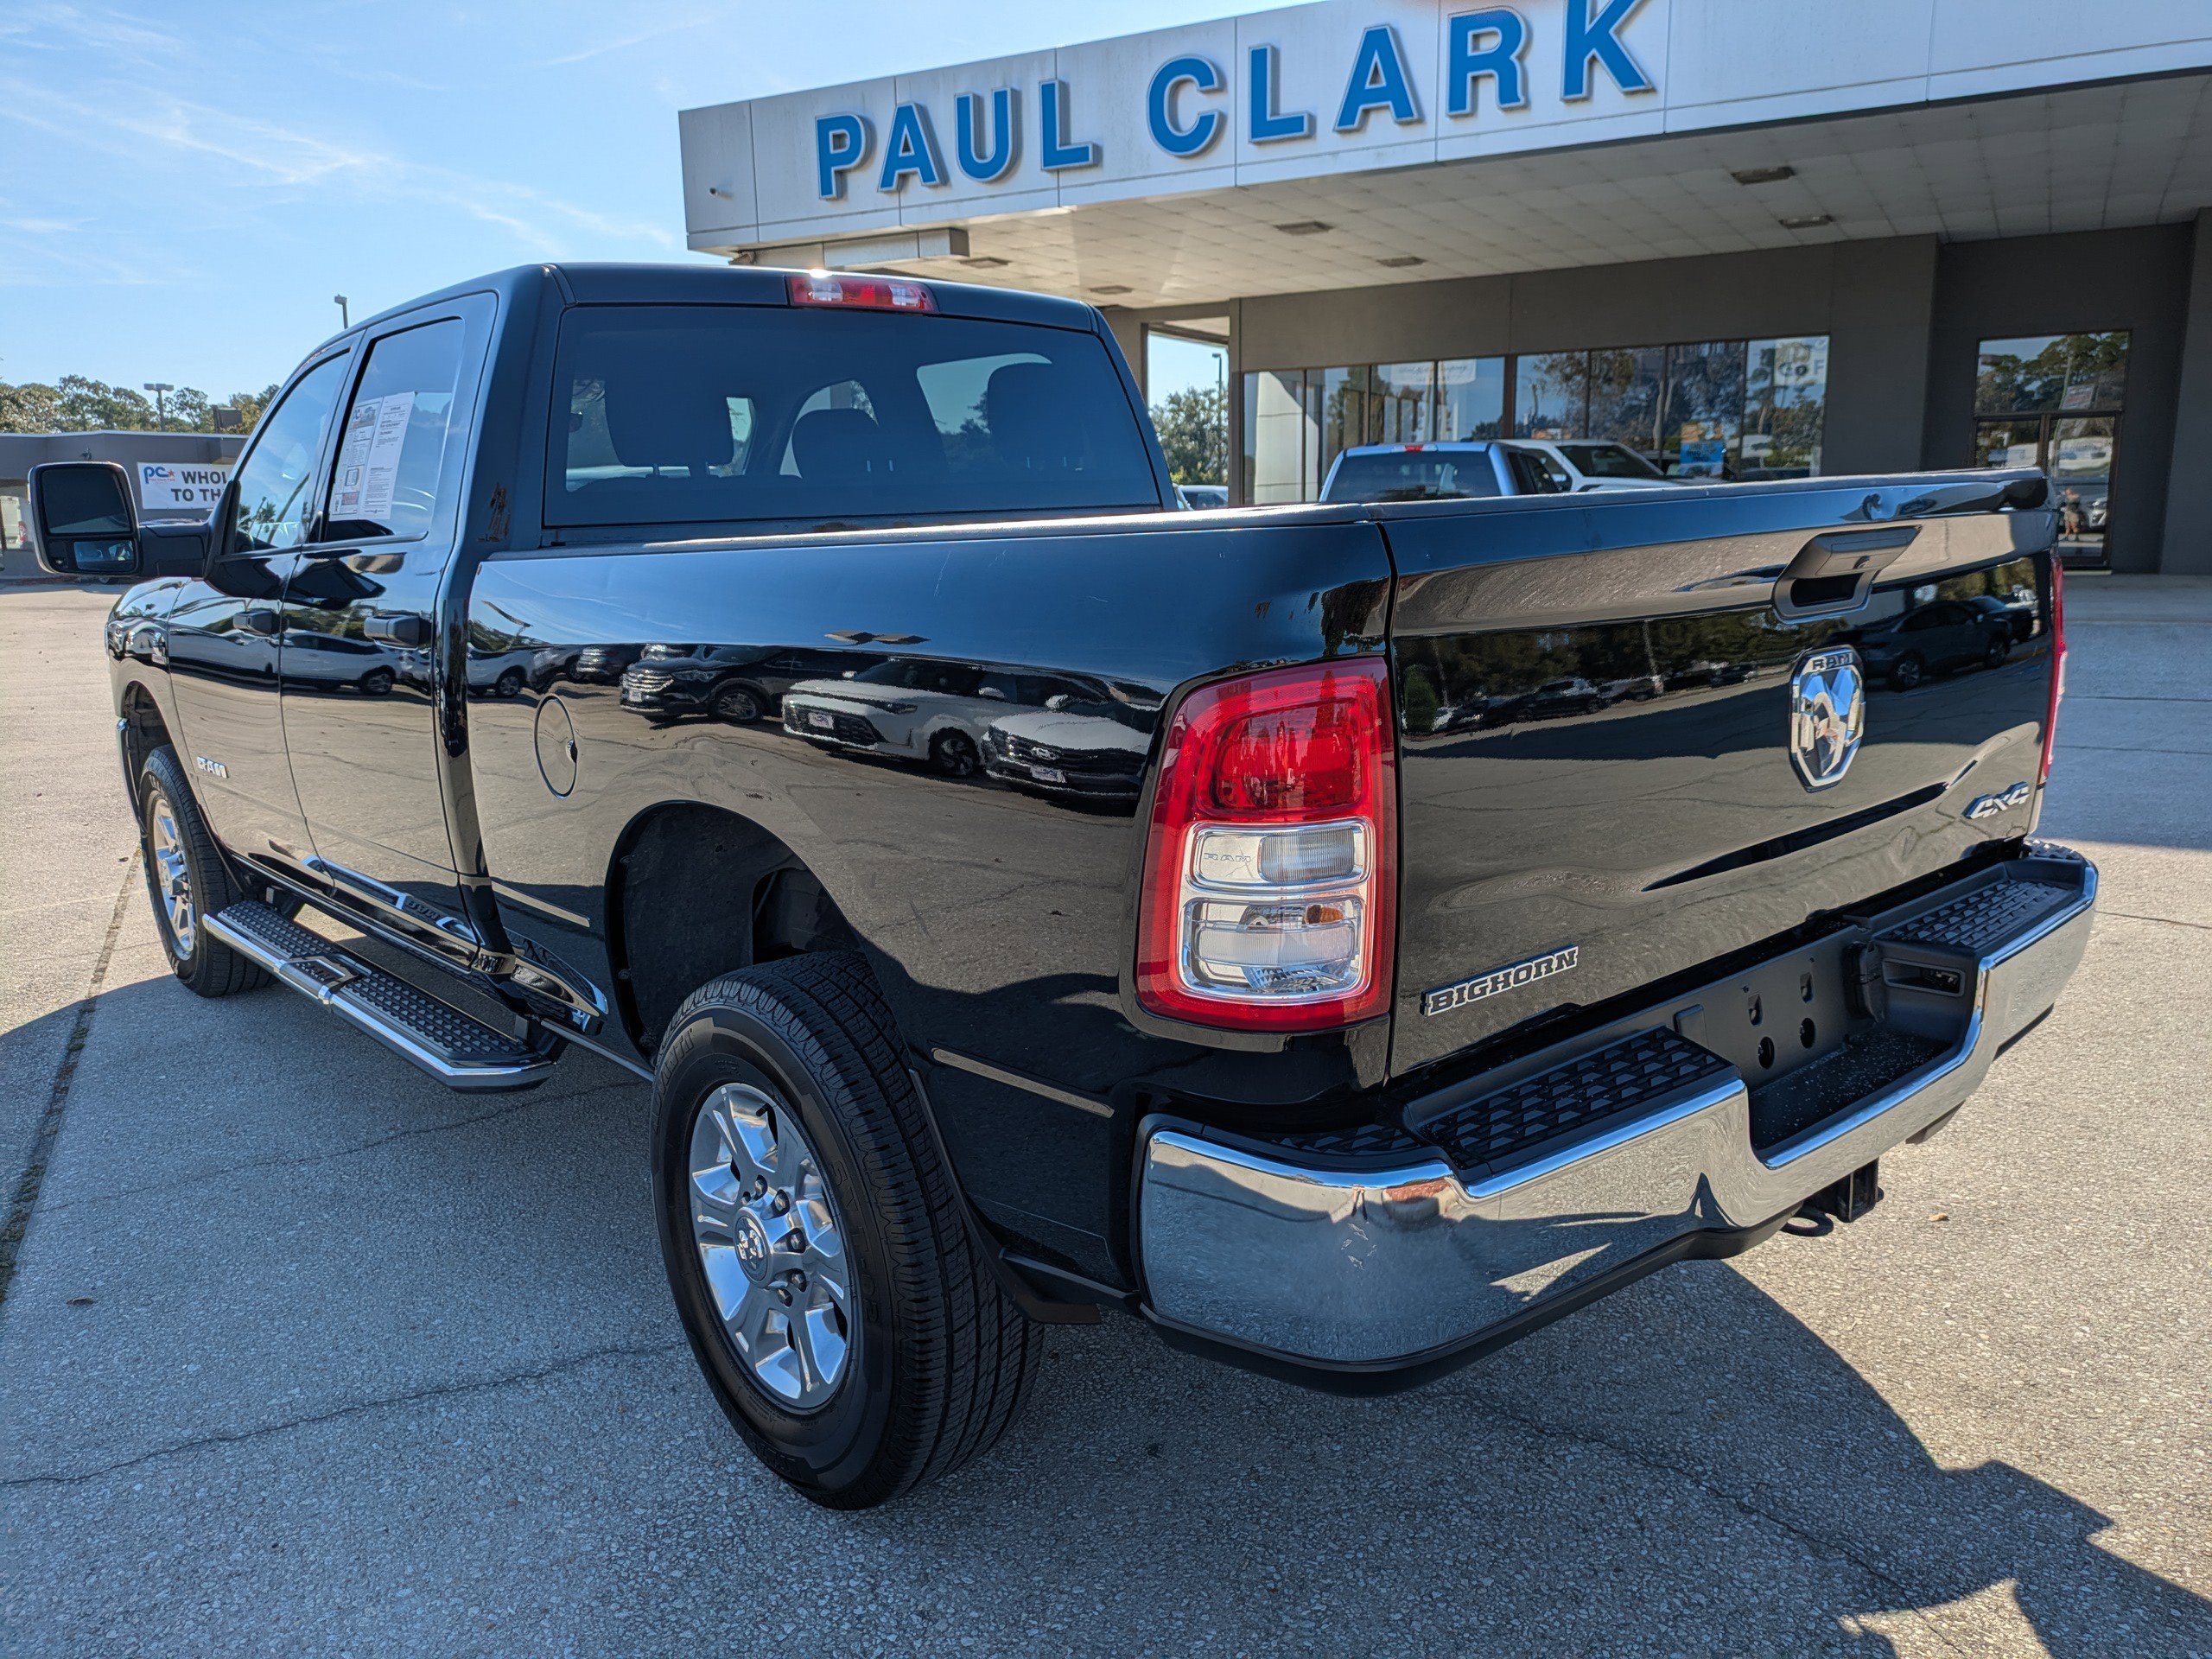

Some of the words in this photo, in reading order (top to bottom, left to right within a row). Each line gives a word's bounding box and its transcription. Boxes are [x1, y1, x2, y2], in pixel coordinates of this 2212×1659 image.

[815, 78, 1100, 200] PAUL
[1147, 0, 1652, 157] CLARK
[171, 488, 194, 501] TO
[1812, 652, 1853, 671] RAM
[197, 757, 228, 779] RAM
[1204, 852, 1251, 862] RAM
[1425, 946, 1579, 1016] BIGHORN
